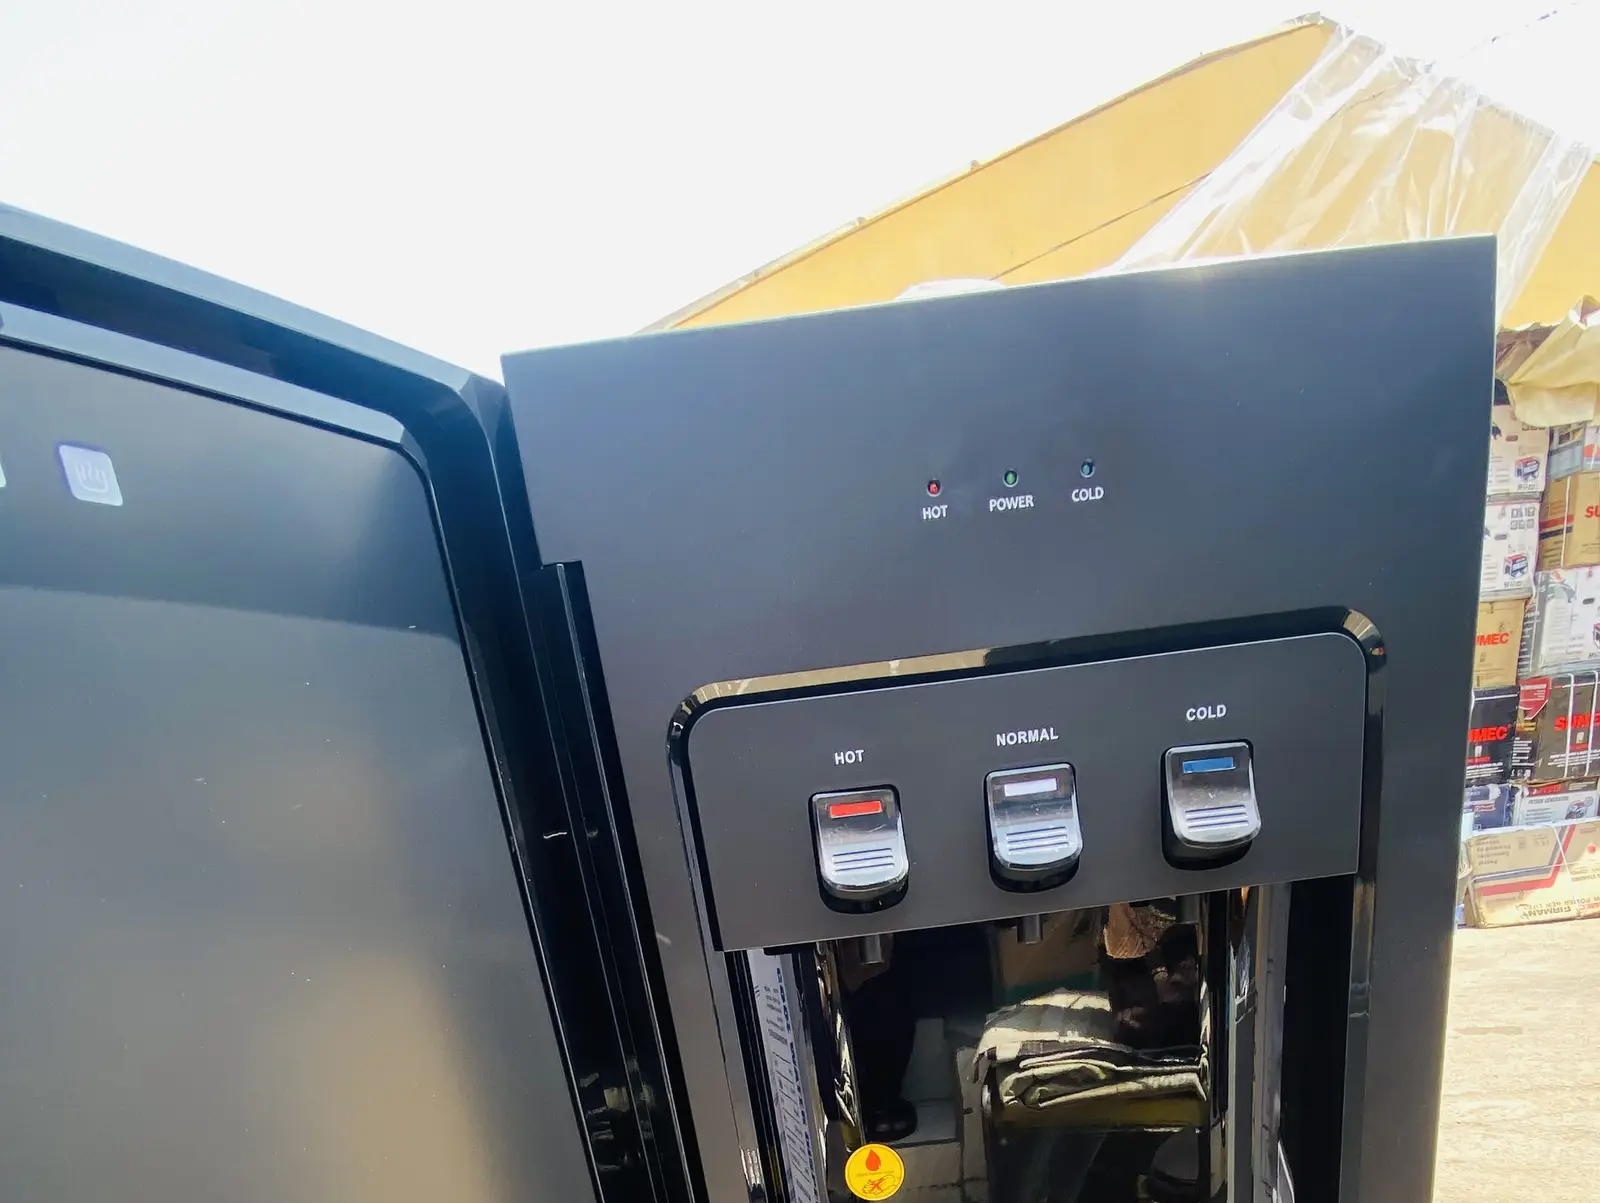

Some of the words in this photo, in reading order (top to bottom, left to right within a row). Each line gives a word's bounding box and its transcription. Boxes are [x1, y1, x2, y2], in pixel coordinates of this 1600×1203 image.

[989, 494, 1034, 512] POWER
[1071, 487, 1104, 502] COLD
[922, 505, 948, 520] HOT
[1474, 631, 1510, 647] MEC
[1185, 703, 1227, 722] COLD
[995, 726, 1059, 746] NORMAL
[834, 749, 865, 766] HOT
